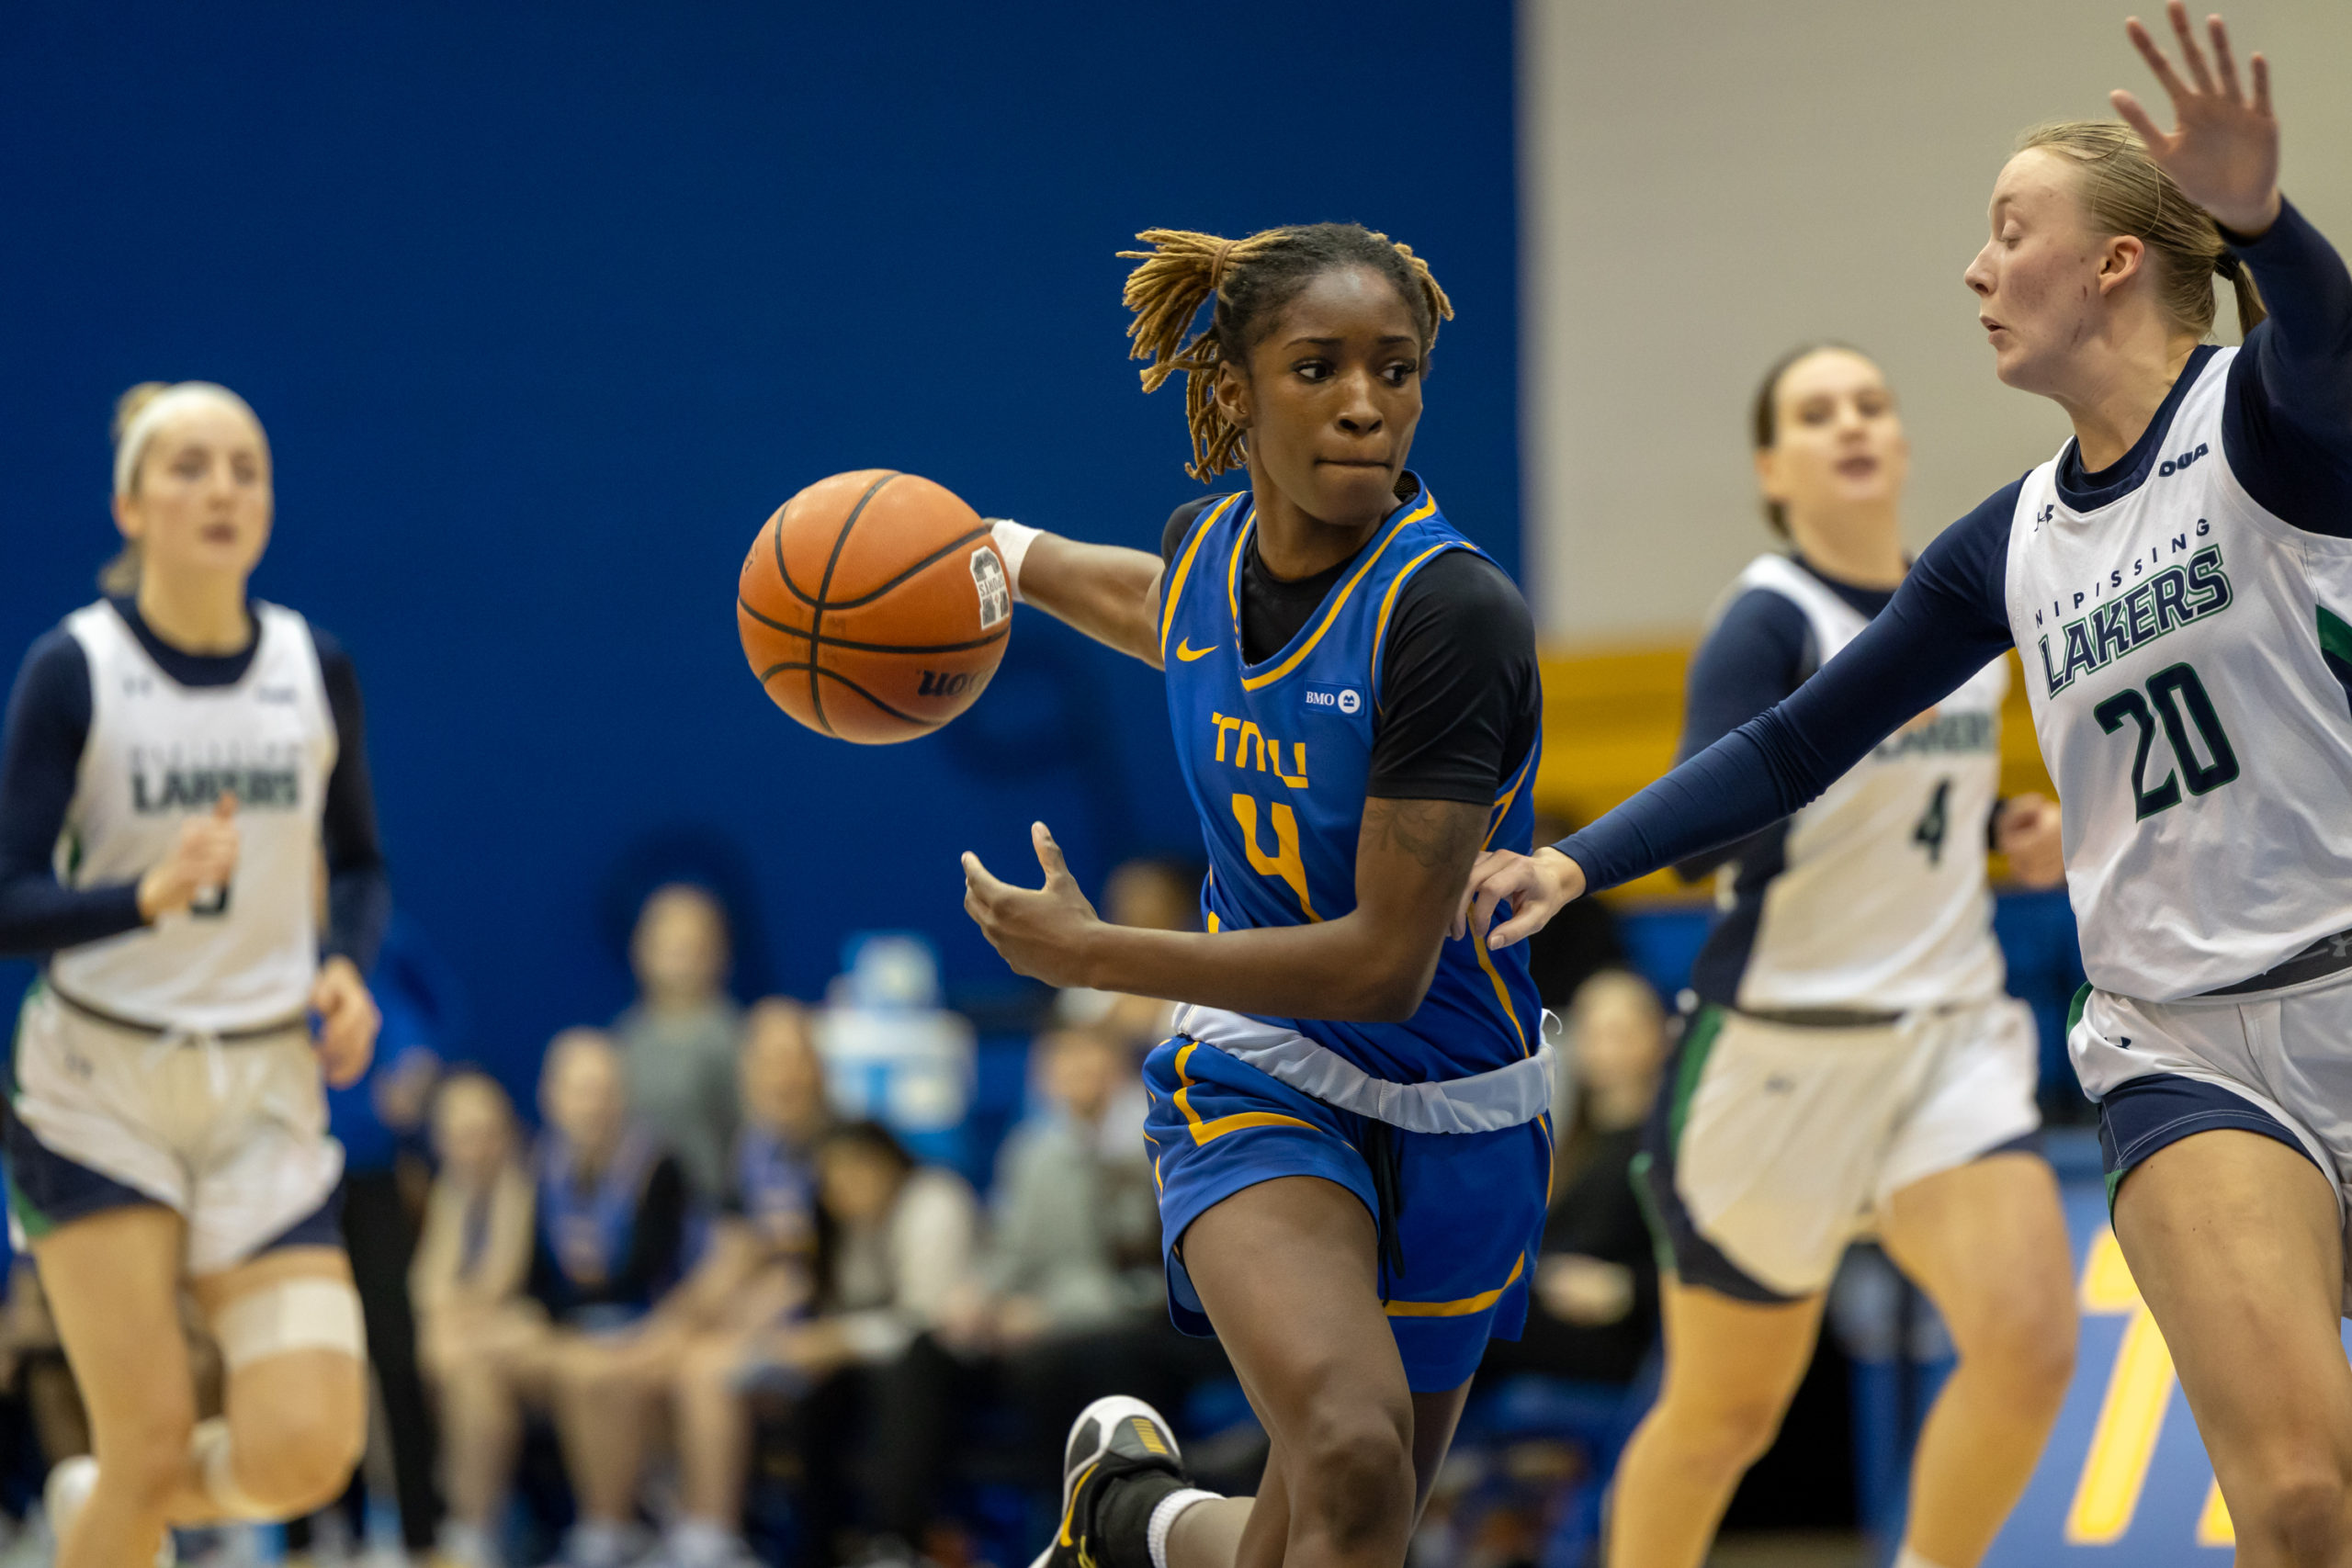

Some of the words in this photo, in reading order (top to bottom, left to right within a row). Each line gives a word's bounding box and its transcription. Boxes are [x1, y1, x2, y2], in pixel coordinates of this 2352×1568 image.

[2158, 442, 2209, 477] OUA
[2034, 518, 2211, 628] NIPISSING
[2038, 543, 2233, 700] LAKERS
[1306, 691, 1335, 706] BMO
[2093, 661, 2240, 823] 20
[1211, 711, 1308, 788] TMU
[1231, 793, 1325, 924] 4
[1910, 776, 1952, 866] 4
